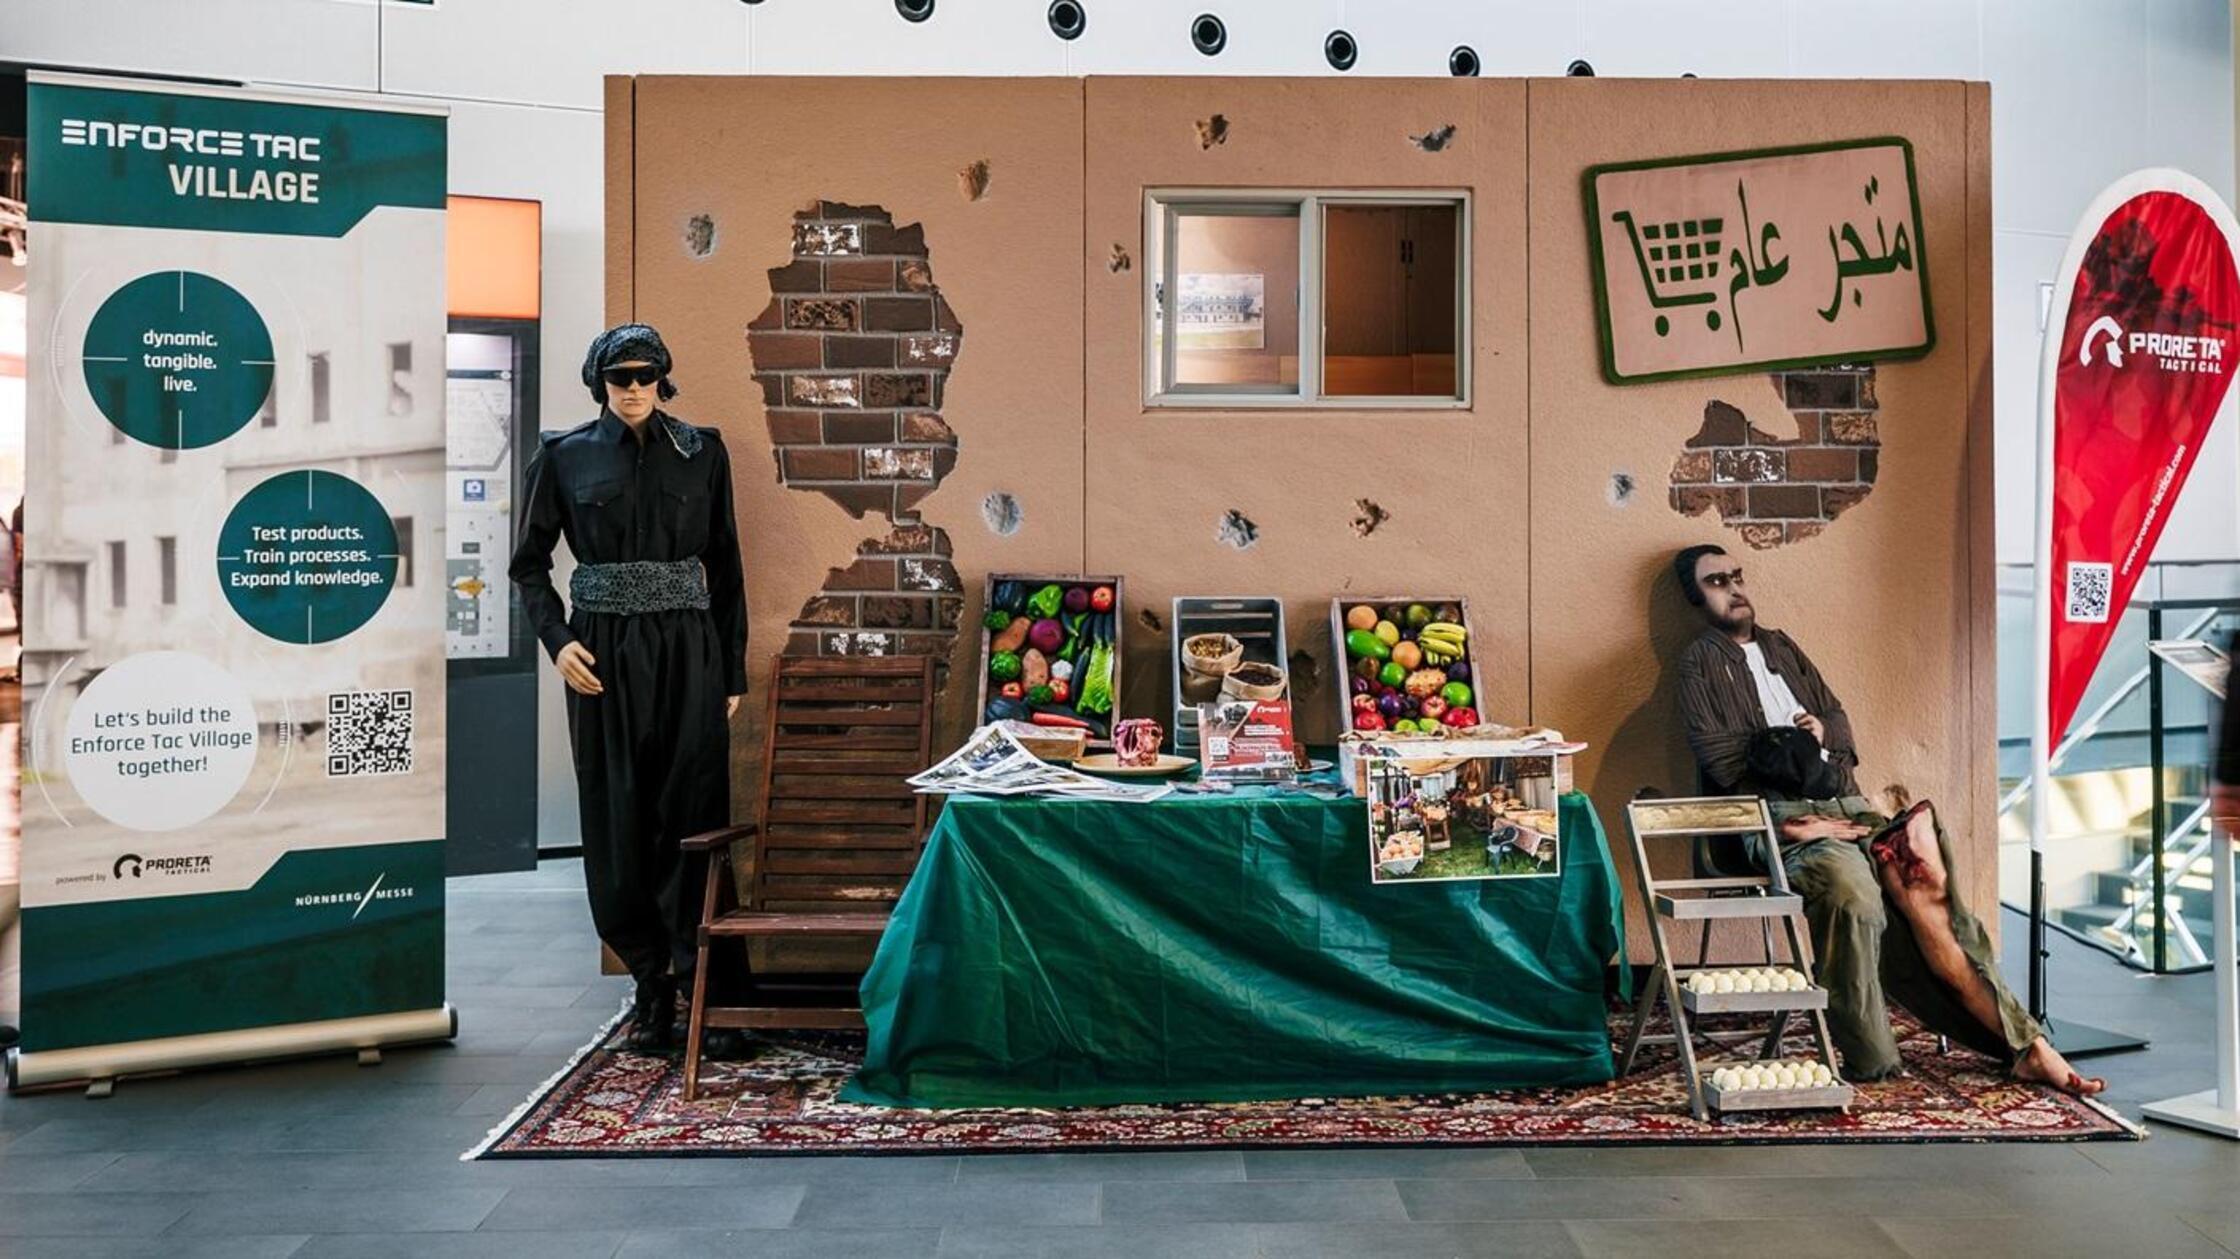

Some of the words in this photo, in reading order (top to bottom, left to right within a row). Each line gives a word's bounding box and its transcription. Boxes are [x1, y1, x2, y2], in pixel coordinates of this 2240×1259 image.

[62, 118, 243, 157] ENFORCE
[250, 133, 321, 162] TAC
[168, 163, 320, 204] VILLAGE
[1816, 174, 1914, 323] متجر
[1730, 177, 1790, 354] عام
[143, 328, 218, 350] dynamic.
[143, 352, 217, 372] tangible.
[2159, 358, 2222, 374] TACTICAL
[163, 375, 197, 393] live.
[2121, 444, 2187, 577] www.proreta-tactical.com
[252, 526, 286, 541] Test
[291, 525, 364, 543] products.
[244, 549, 286, 564] Train
[289, 550, 372, 566] processes.
[231, 571, 291, 588] Expand
[295, 570, 384, 587] knowledge.
[94, 711, 140, 729] Let's
[146, 708, 194, 726] build
[200, 707, 231, 723] the
[71, 735, 145, 754] Enforce
[152, 734, 183, 750] Tac
[189, 731, 253, 750] Village
[118, 756, 208, 778] together!
[55, 874, 94, 885] powered
[95, 872, 106, 882] by
